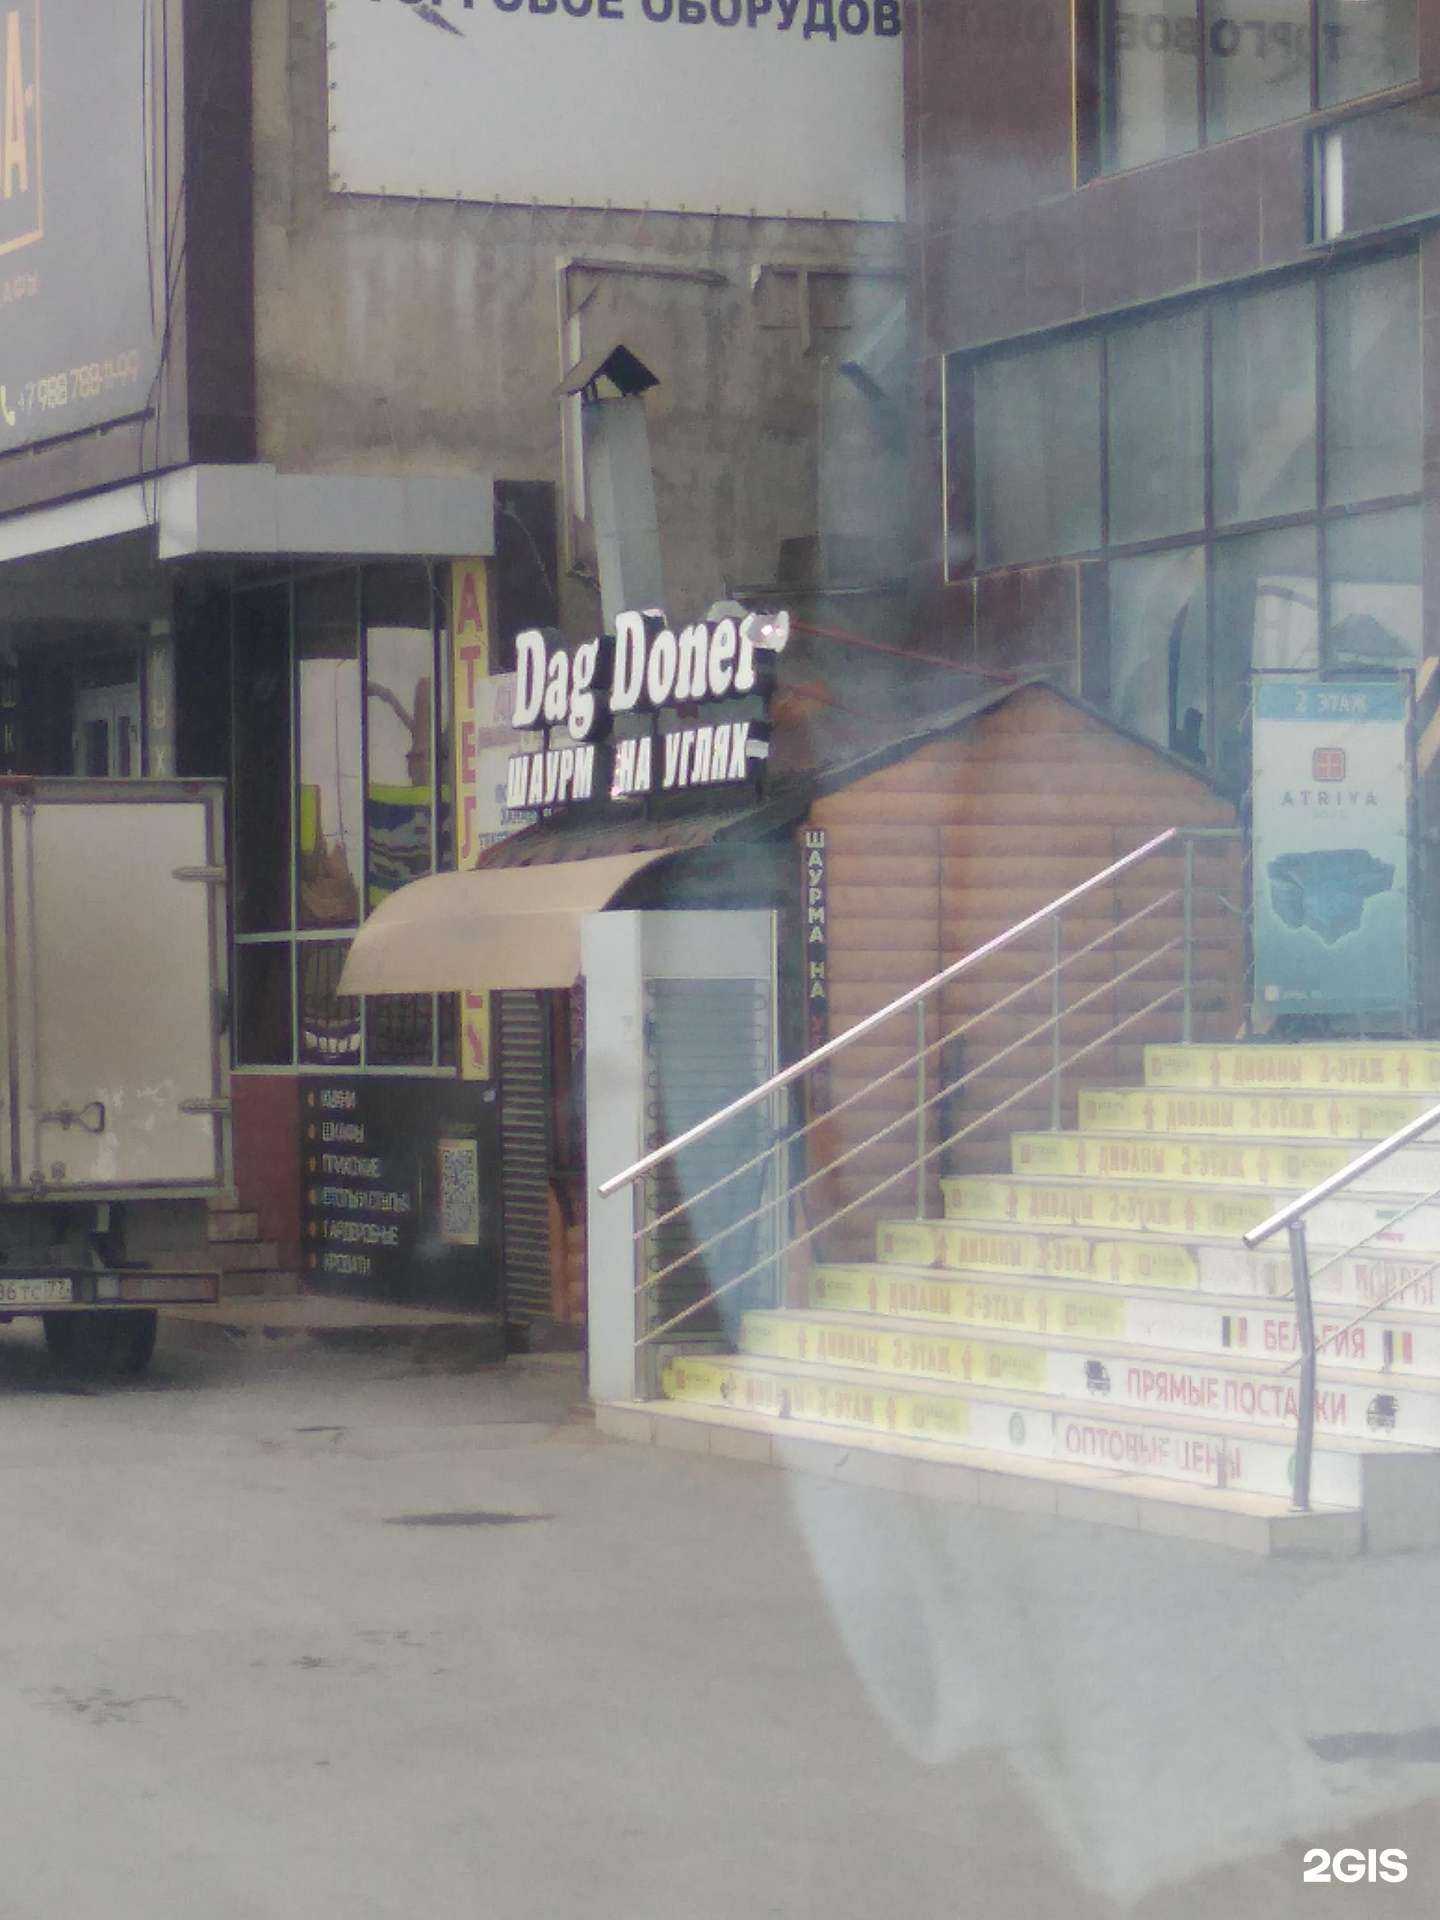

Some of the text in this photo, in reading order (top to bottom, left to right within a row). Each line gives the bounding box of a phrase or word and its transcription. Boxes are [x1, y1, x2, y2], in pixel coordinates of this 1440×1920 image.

[511, 609, 789, 740] Dag Doner
[1280, 790, 1379, 808] ATRIYA
[805, 830, 826, 943] ШАУРМА
[809, 960, 826, 998] НА
[1263, 1318, 1366, 1359] БЕЛГИЯ
[1126, 1367, 1348, 1425] ПРЯМЫЕ ПОСТАКИ
[1065, 1423, 1169, 1467] ОПТОВЫЕ
